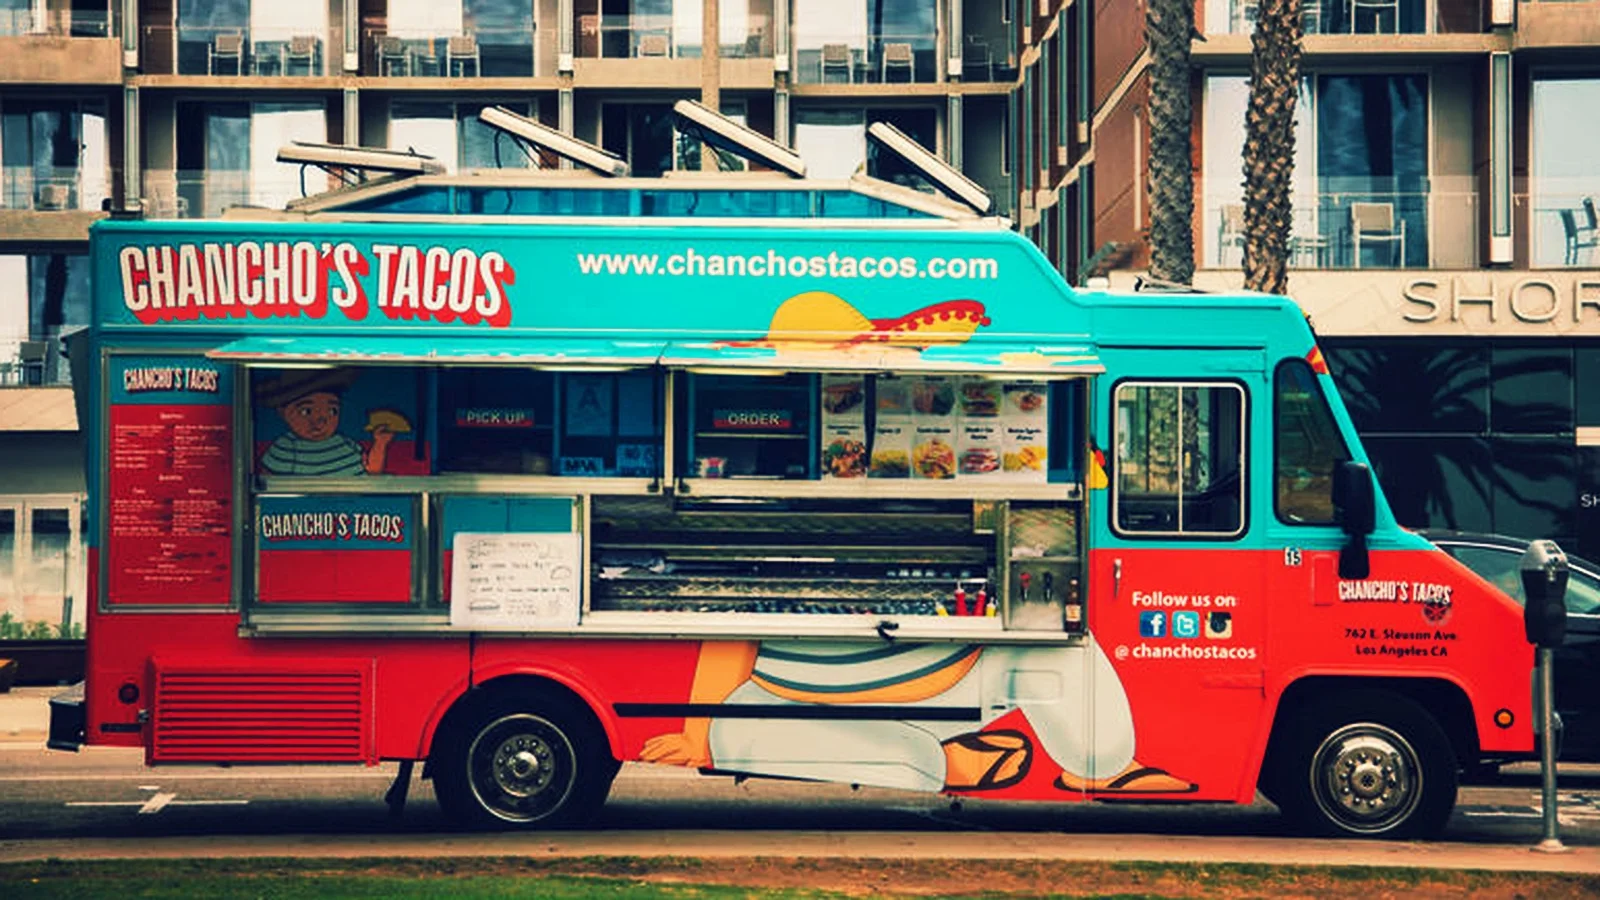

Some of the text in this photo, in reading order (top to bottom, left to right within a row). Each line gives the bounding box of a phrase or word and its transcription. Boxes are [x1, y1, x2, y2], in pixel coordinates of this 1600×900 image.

[577, 248, 999, 280] www.chanchostacos.com
[119, 241, 506, 317] CHANCHO'S TACOS
[124, 367, 219, 393] CHANCHO'S TACOS
[466, 411, 526, 424] PICK UP
[728, 412, 780, 426] ORDER
[262, 512, 403, 541] CHANCHO'S TACOS
[1132, 591, 1236, 607] Follow us on
[1338, 580, 1452, 606] CHANCHO'S TACOS
[1345, 628, 1367, 639] 762
[1356, 645, 1448, 658] Los Angeles CA
